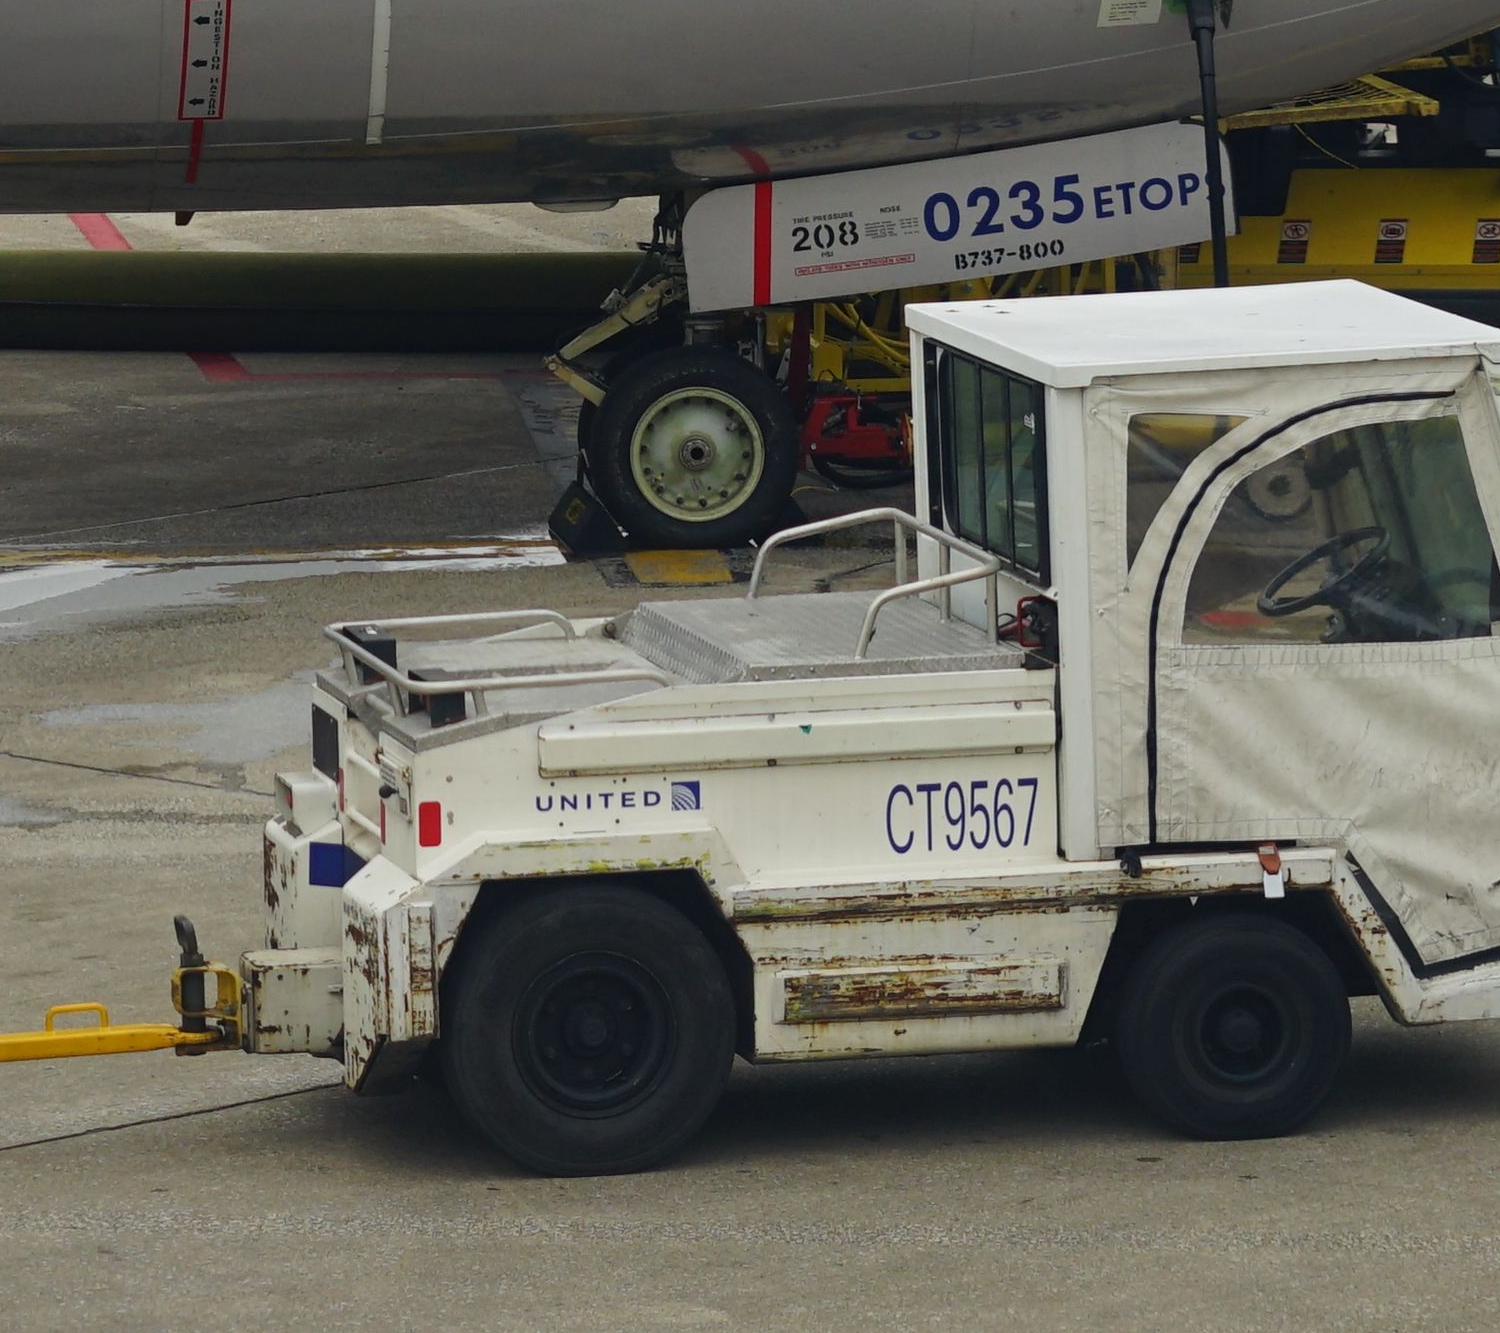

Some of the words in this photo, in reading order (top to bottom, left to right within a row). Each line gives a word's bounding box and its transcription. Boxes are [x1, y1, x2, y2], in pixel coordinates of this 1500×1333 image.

[211, 1, 223, 71] INGESTION
[207, 77, 219, 116] HAZARD
[813, 211, 854, 222] PRESSURE
[879, 205, 902, 214] NOSE
[923, 174, 1085, 242] 0235
[1094, 172, 1226, 219] ETOP
[791, 220, 860, 252] 208
[954, 239, 1065, 271] B737-800
[536, 791, 661, 812] UNITED
[886, 778, 1039, 854] CT9567
